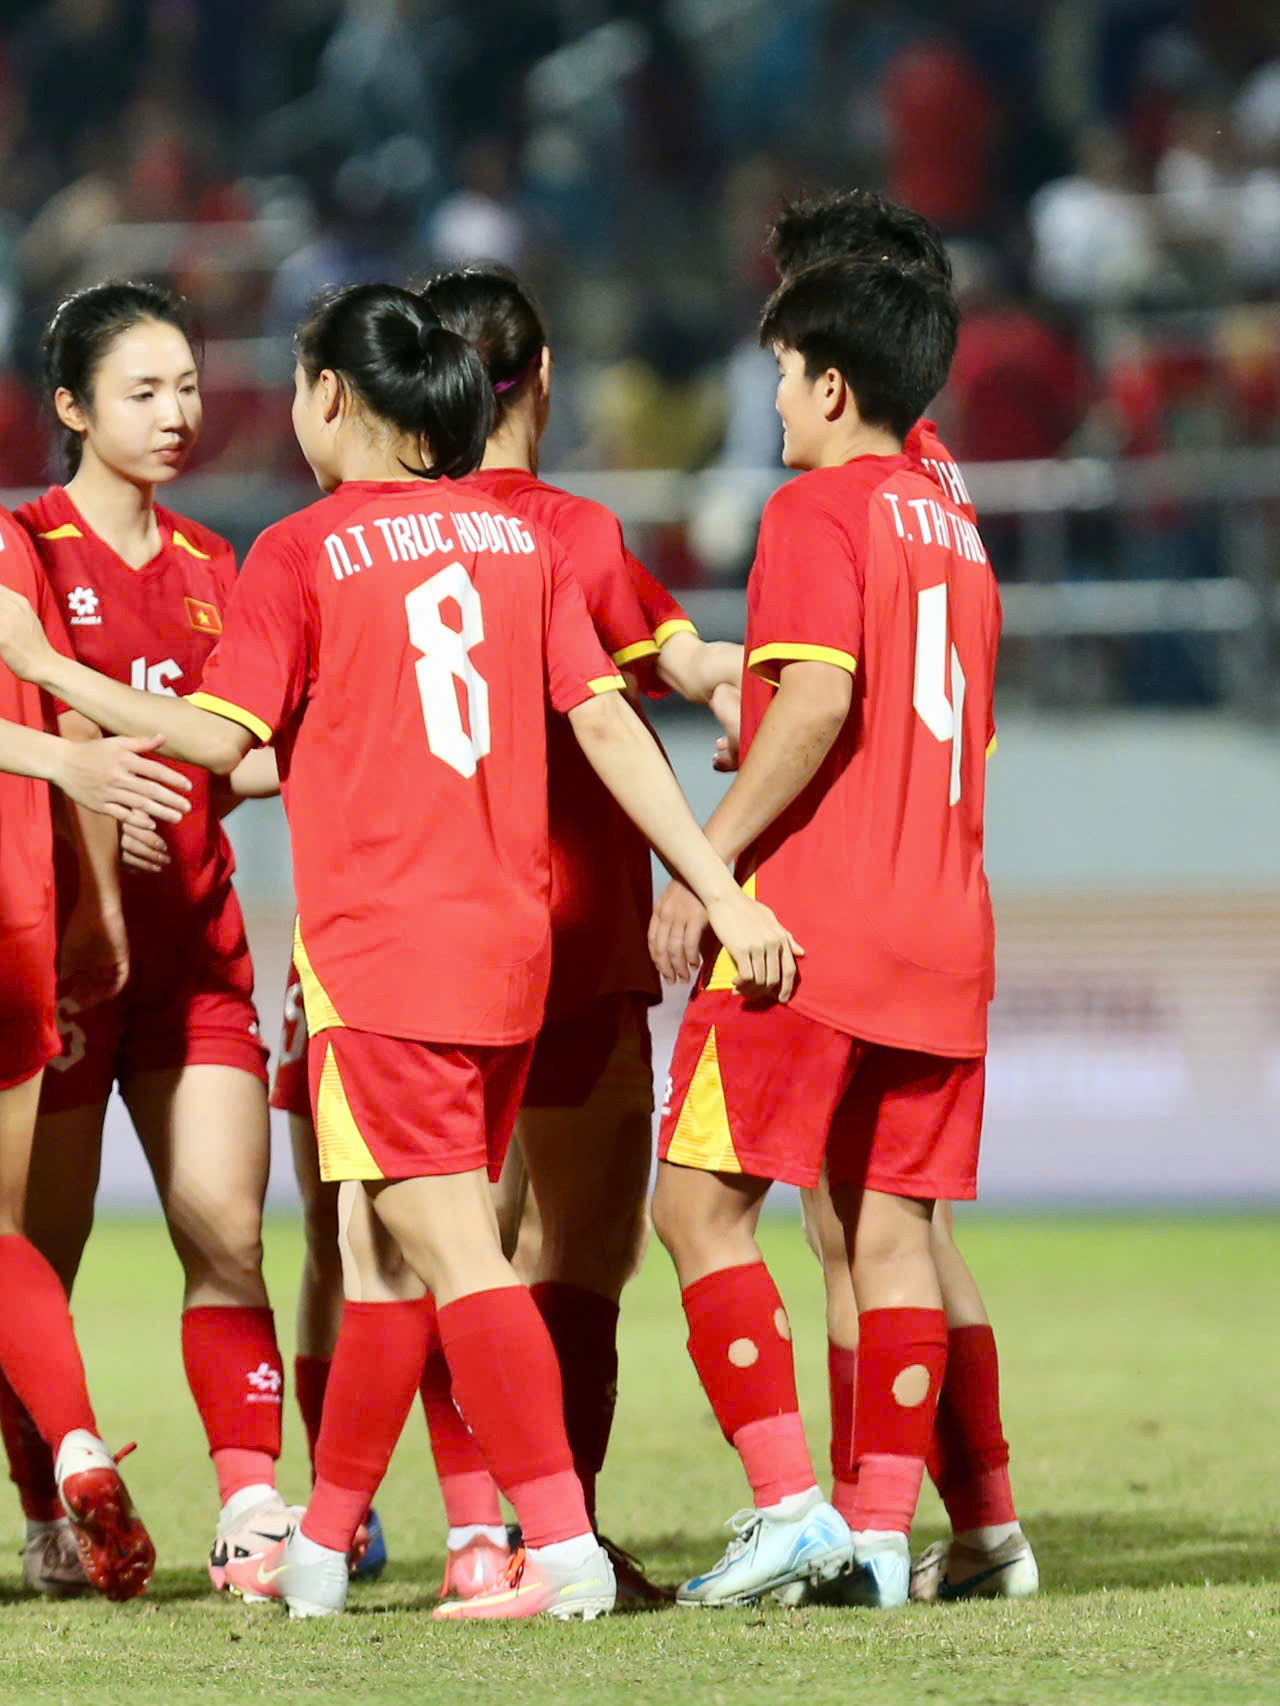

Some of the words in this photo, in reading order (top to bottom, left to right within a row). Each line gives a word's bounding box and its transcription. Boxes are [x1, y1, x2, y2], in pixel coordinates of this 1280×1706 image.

[373, 511, 455, 563] TRUC
[404, 560, 491, 780] 8
[912, 581, 967, 808] 4
